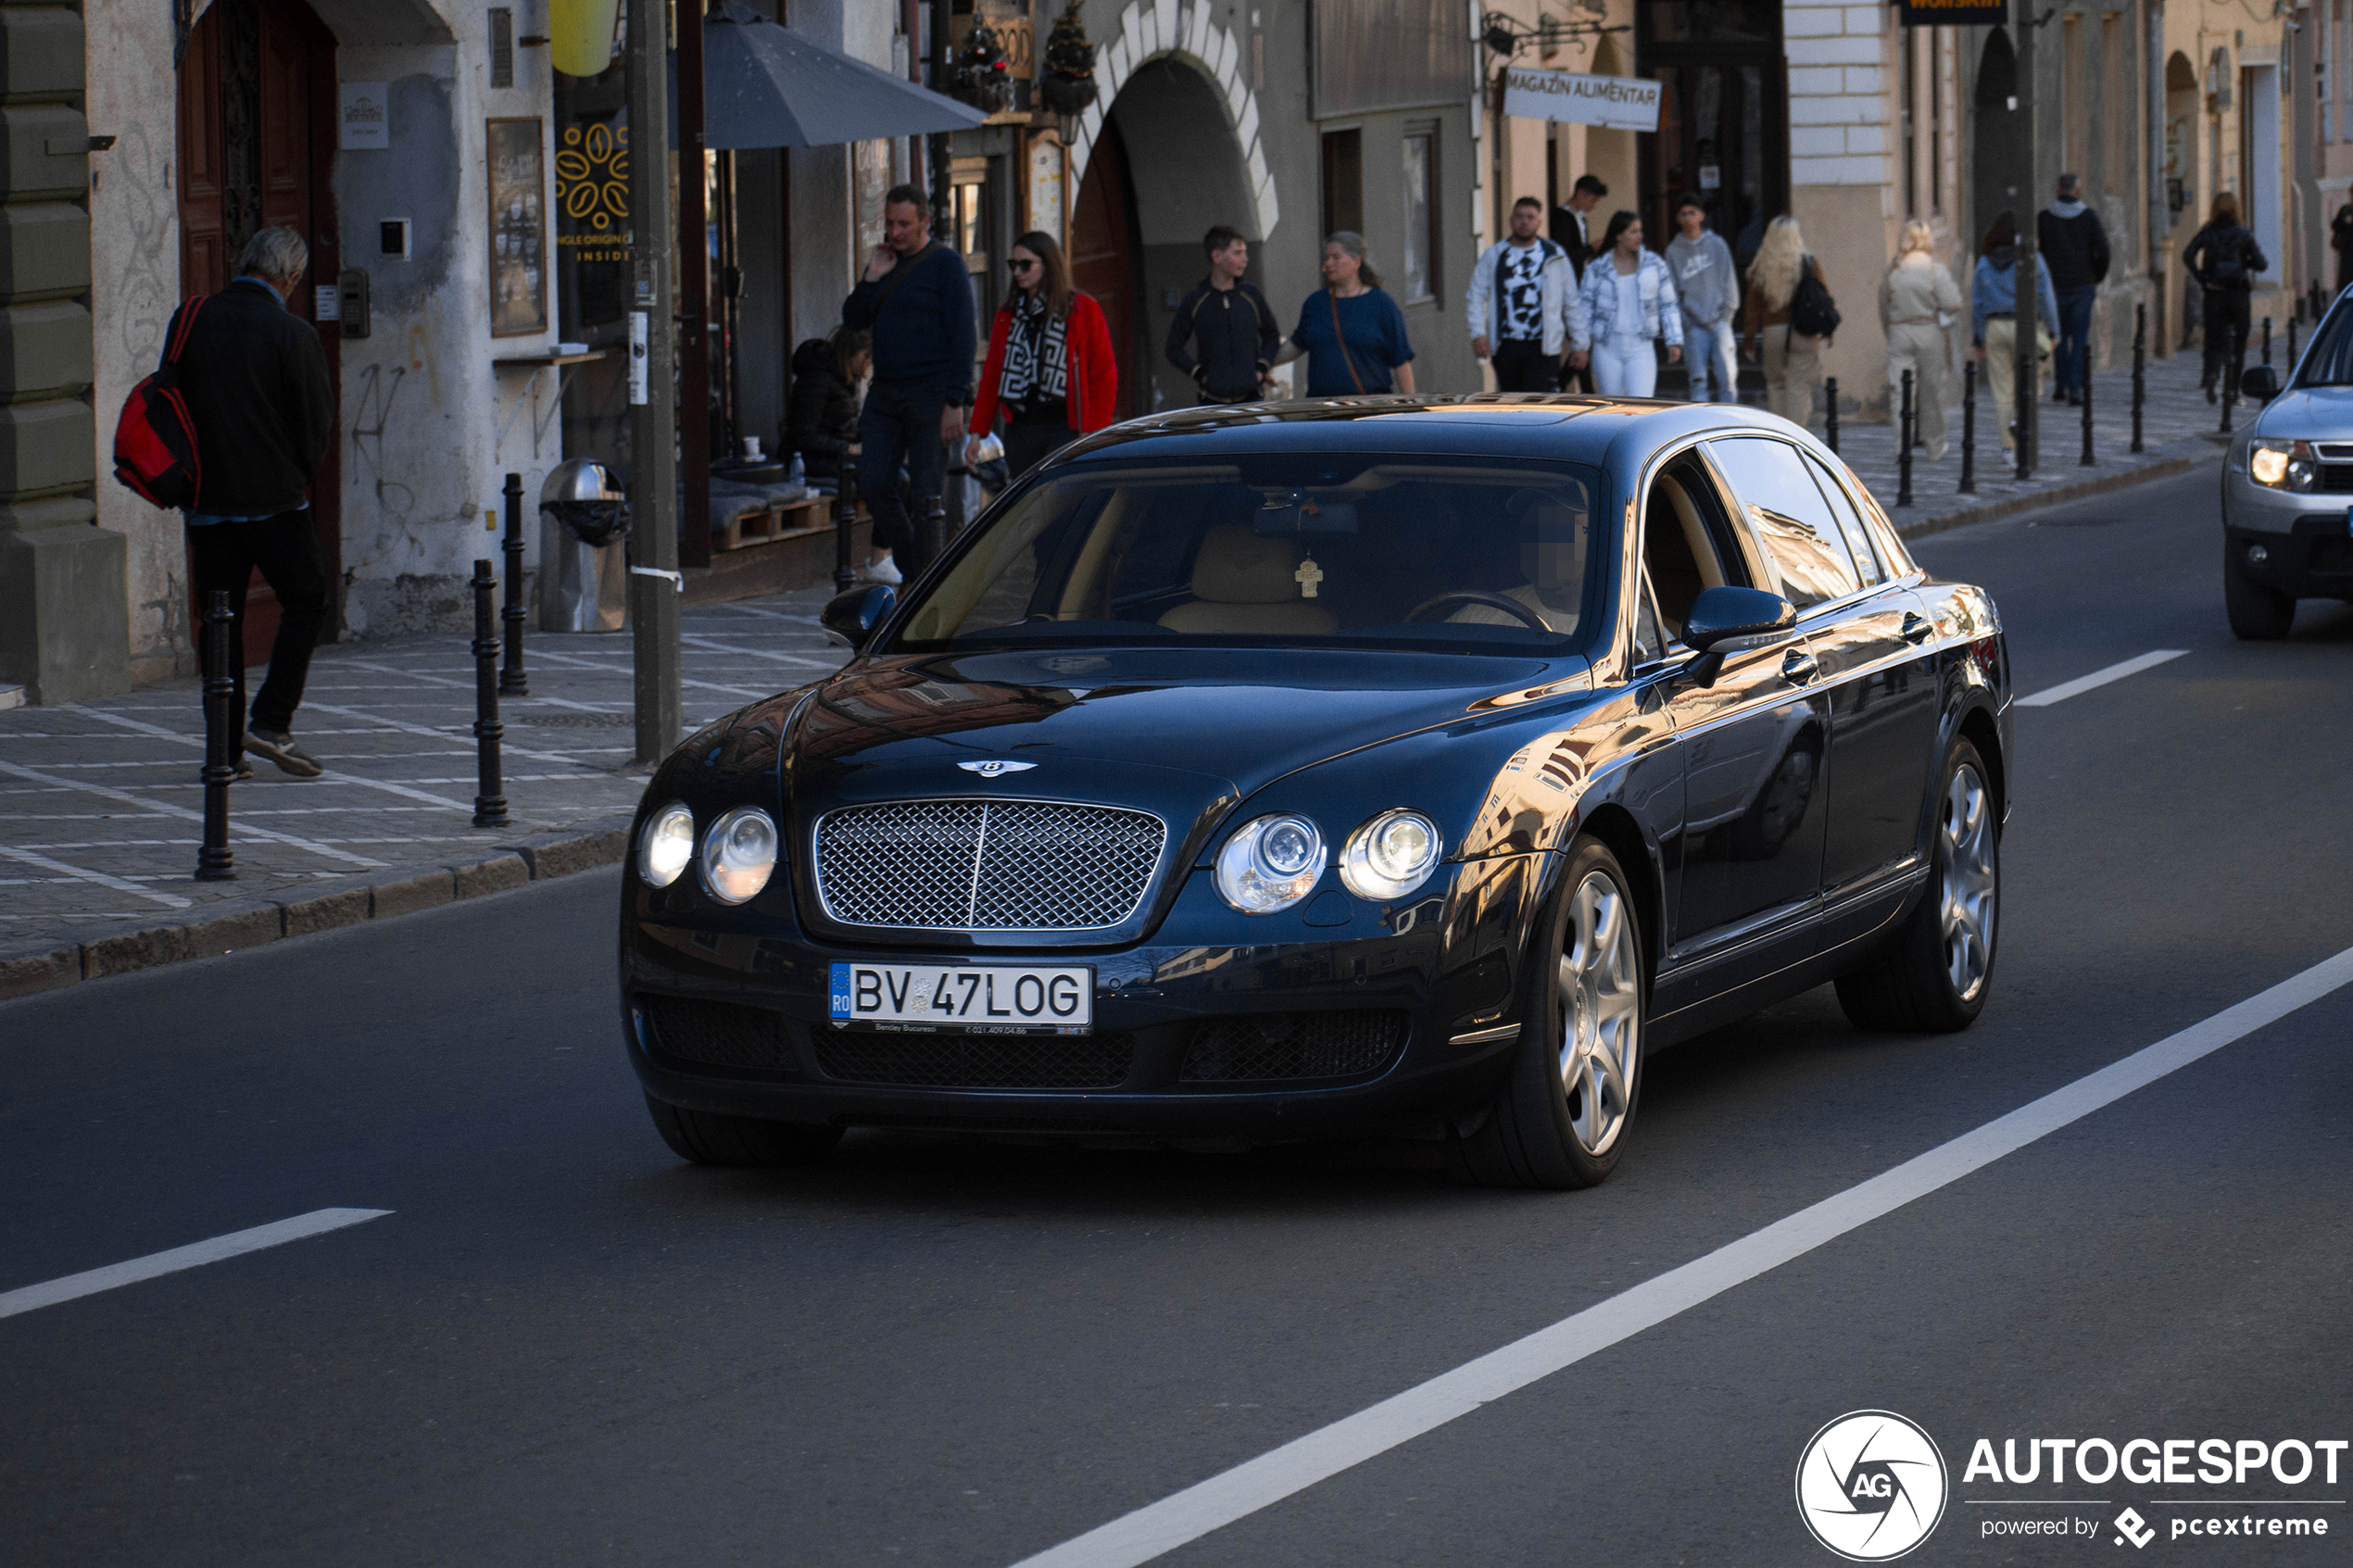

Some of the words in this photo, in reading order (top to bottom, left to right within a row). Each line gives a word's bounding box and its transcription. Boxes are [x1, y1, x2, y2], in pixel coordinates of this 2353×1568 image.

[1573, 81, 1657, 106] ALIMENTAR
[584, 233, 622, 245] ORIGIN
[855, 969, 912, 1014] BV
[833, 994, 850, 1012] RO
